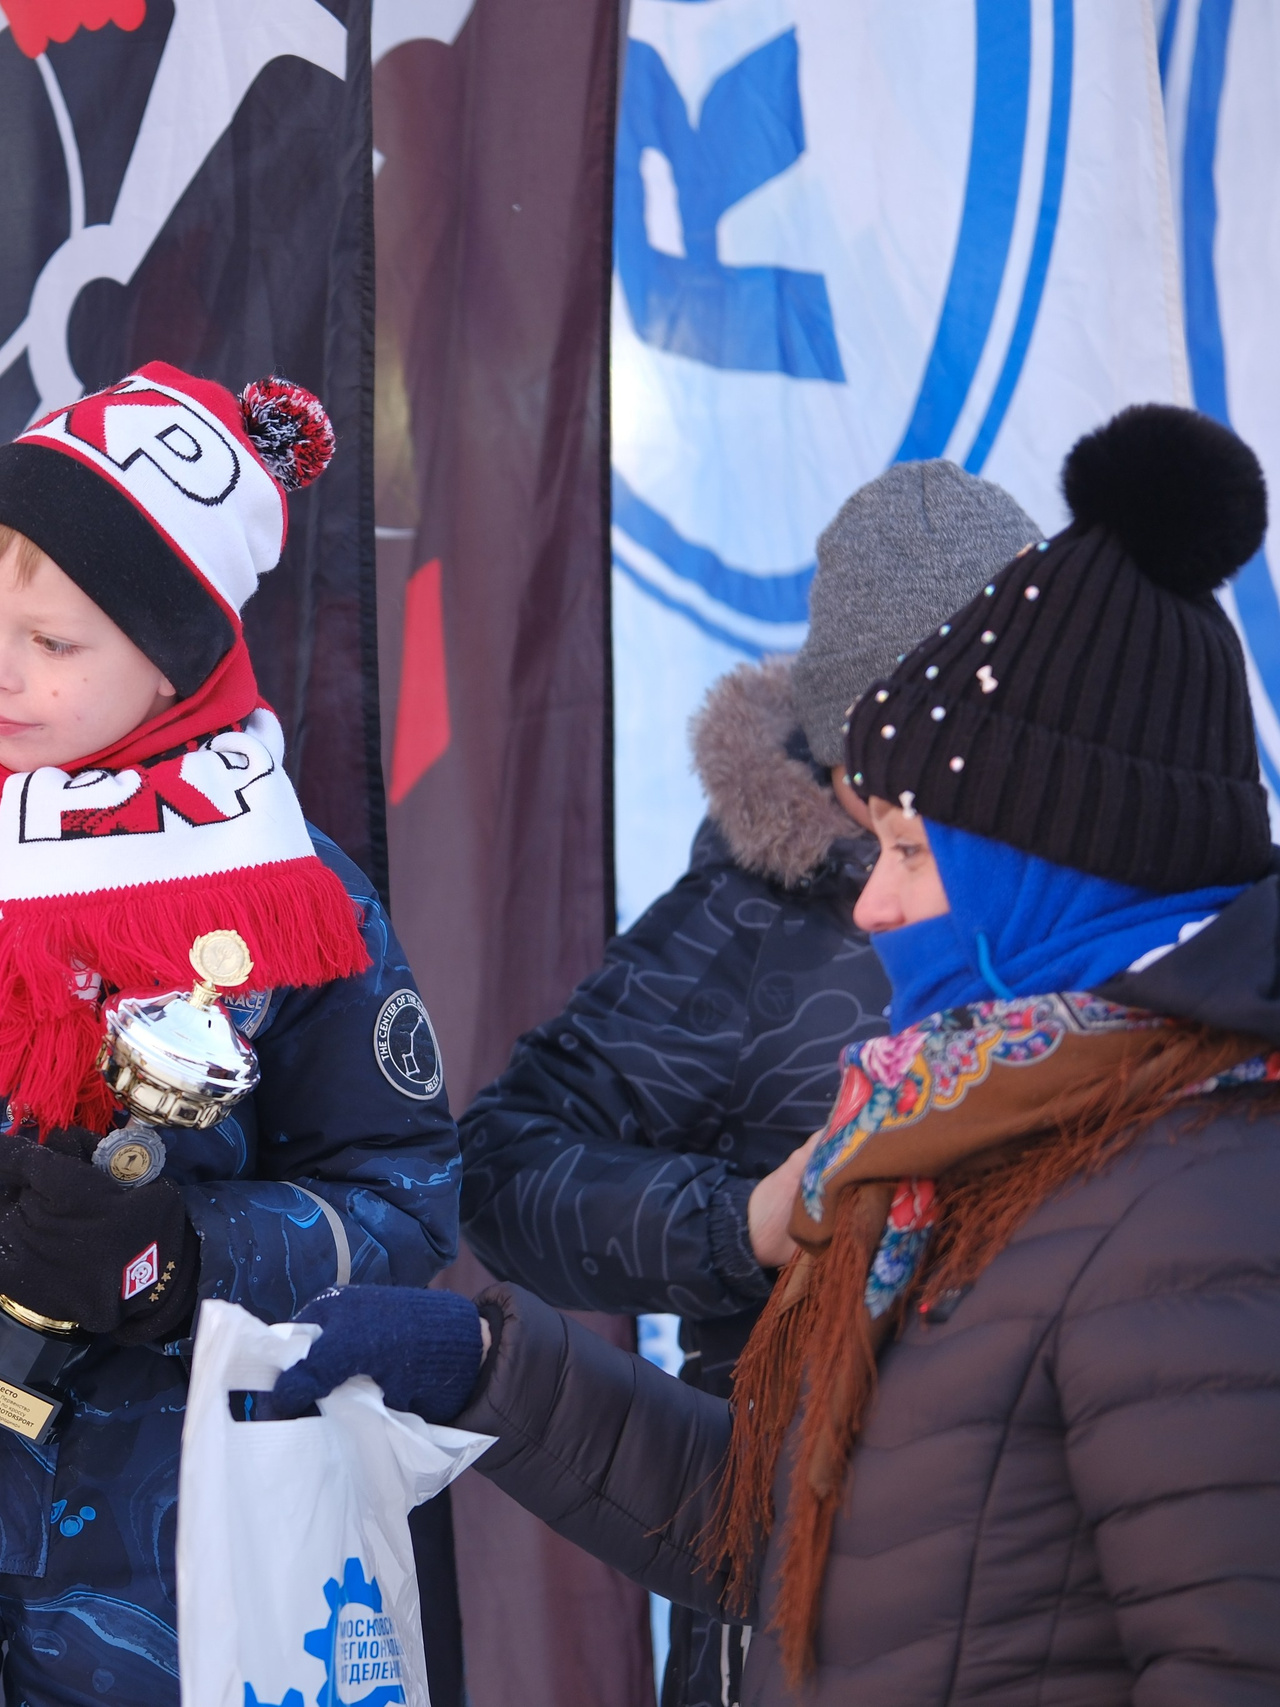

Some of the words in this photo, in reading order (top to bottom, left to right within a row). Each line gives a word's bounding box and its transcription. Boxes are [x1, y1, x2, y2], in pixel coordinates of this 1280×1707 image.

[396, 995, 406, 1006] OF
[378, 1003, 398, 1039] CENTER
[378, 1041, 389, 1062] THE
[0, 1394, 31, 1413] Первенство
[9, 1405, 26, 1418] кроссу
